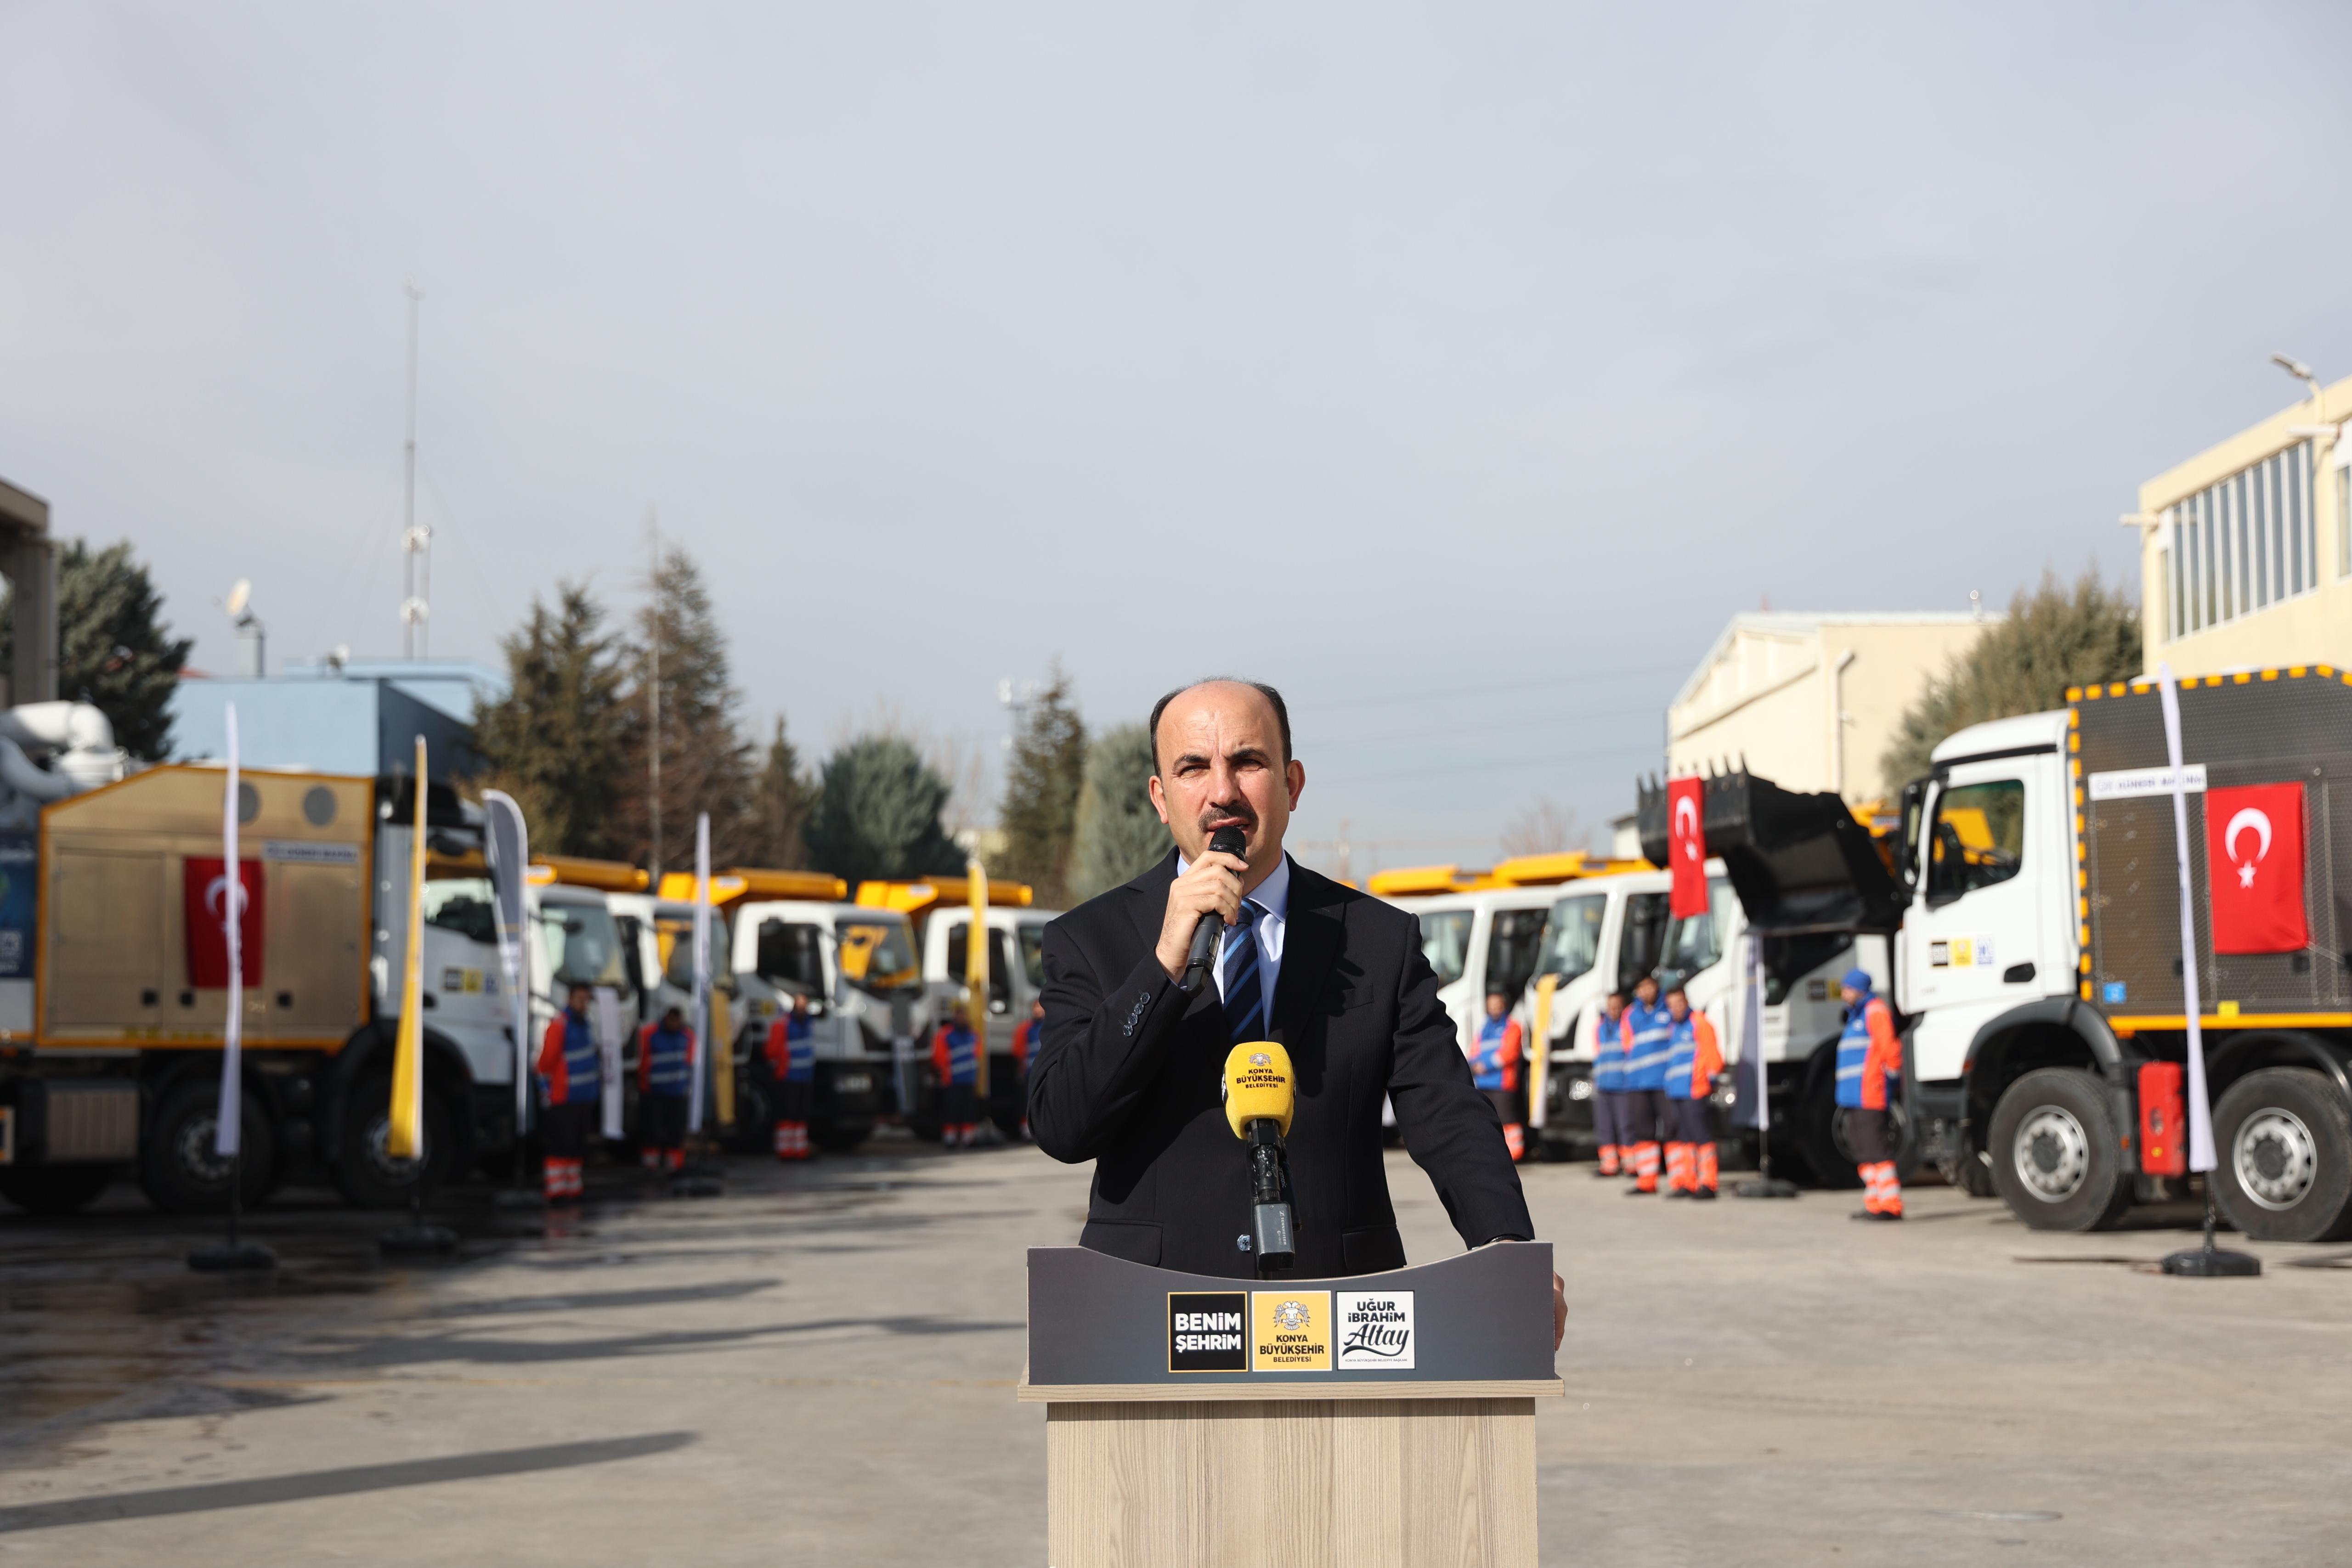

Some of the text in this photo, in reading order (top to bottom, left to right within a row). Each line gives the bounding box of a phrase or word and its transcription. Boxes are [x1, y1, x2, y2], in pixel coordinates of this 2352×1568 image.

[1236, 1074, 1285, 1084] BÜYÜKŞEHİR
[1278, 1167, 1287, 1188] aramonic
[1357, 1298, 1395, 1311] UĞUR
[1342, 1323, 1410, 1357] Altay
[1260, 1343, 1324, 1355] BÜYÜKŞEHİR
